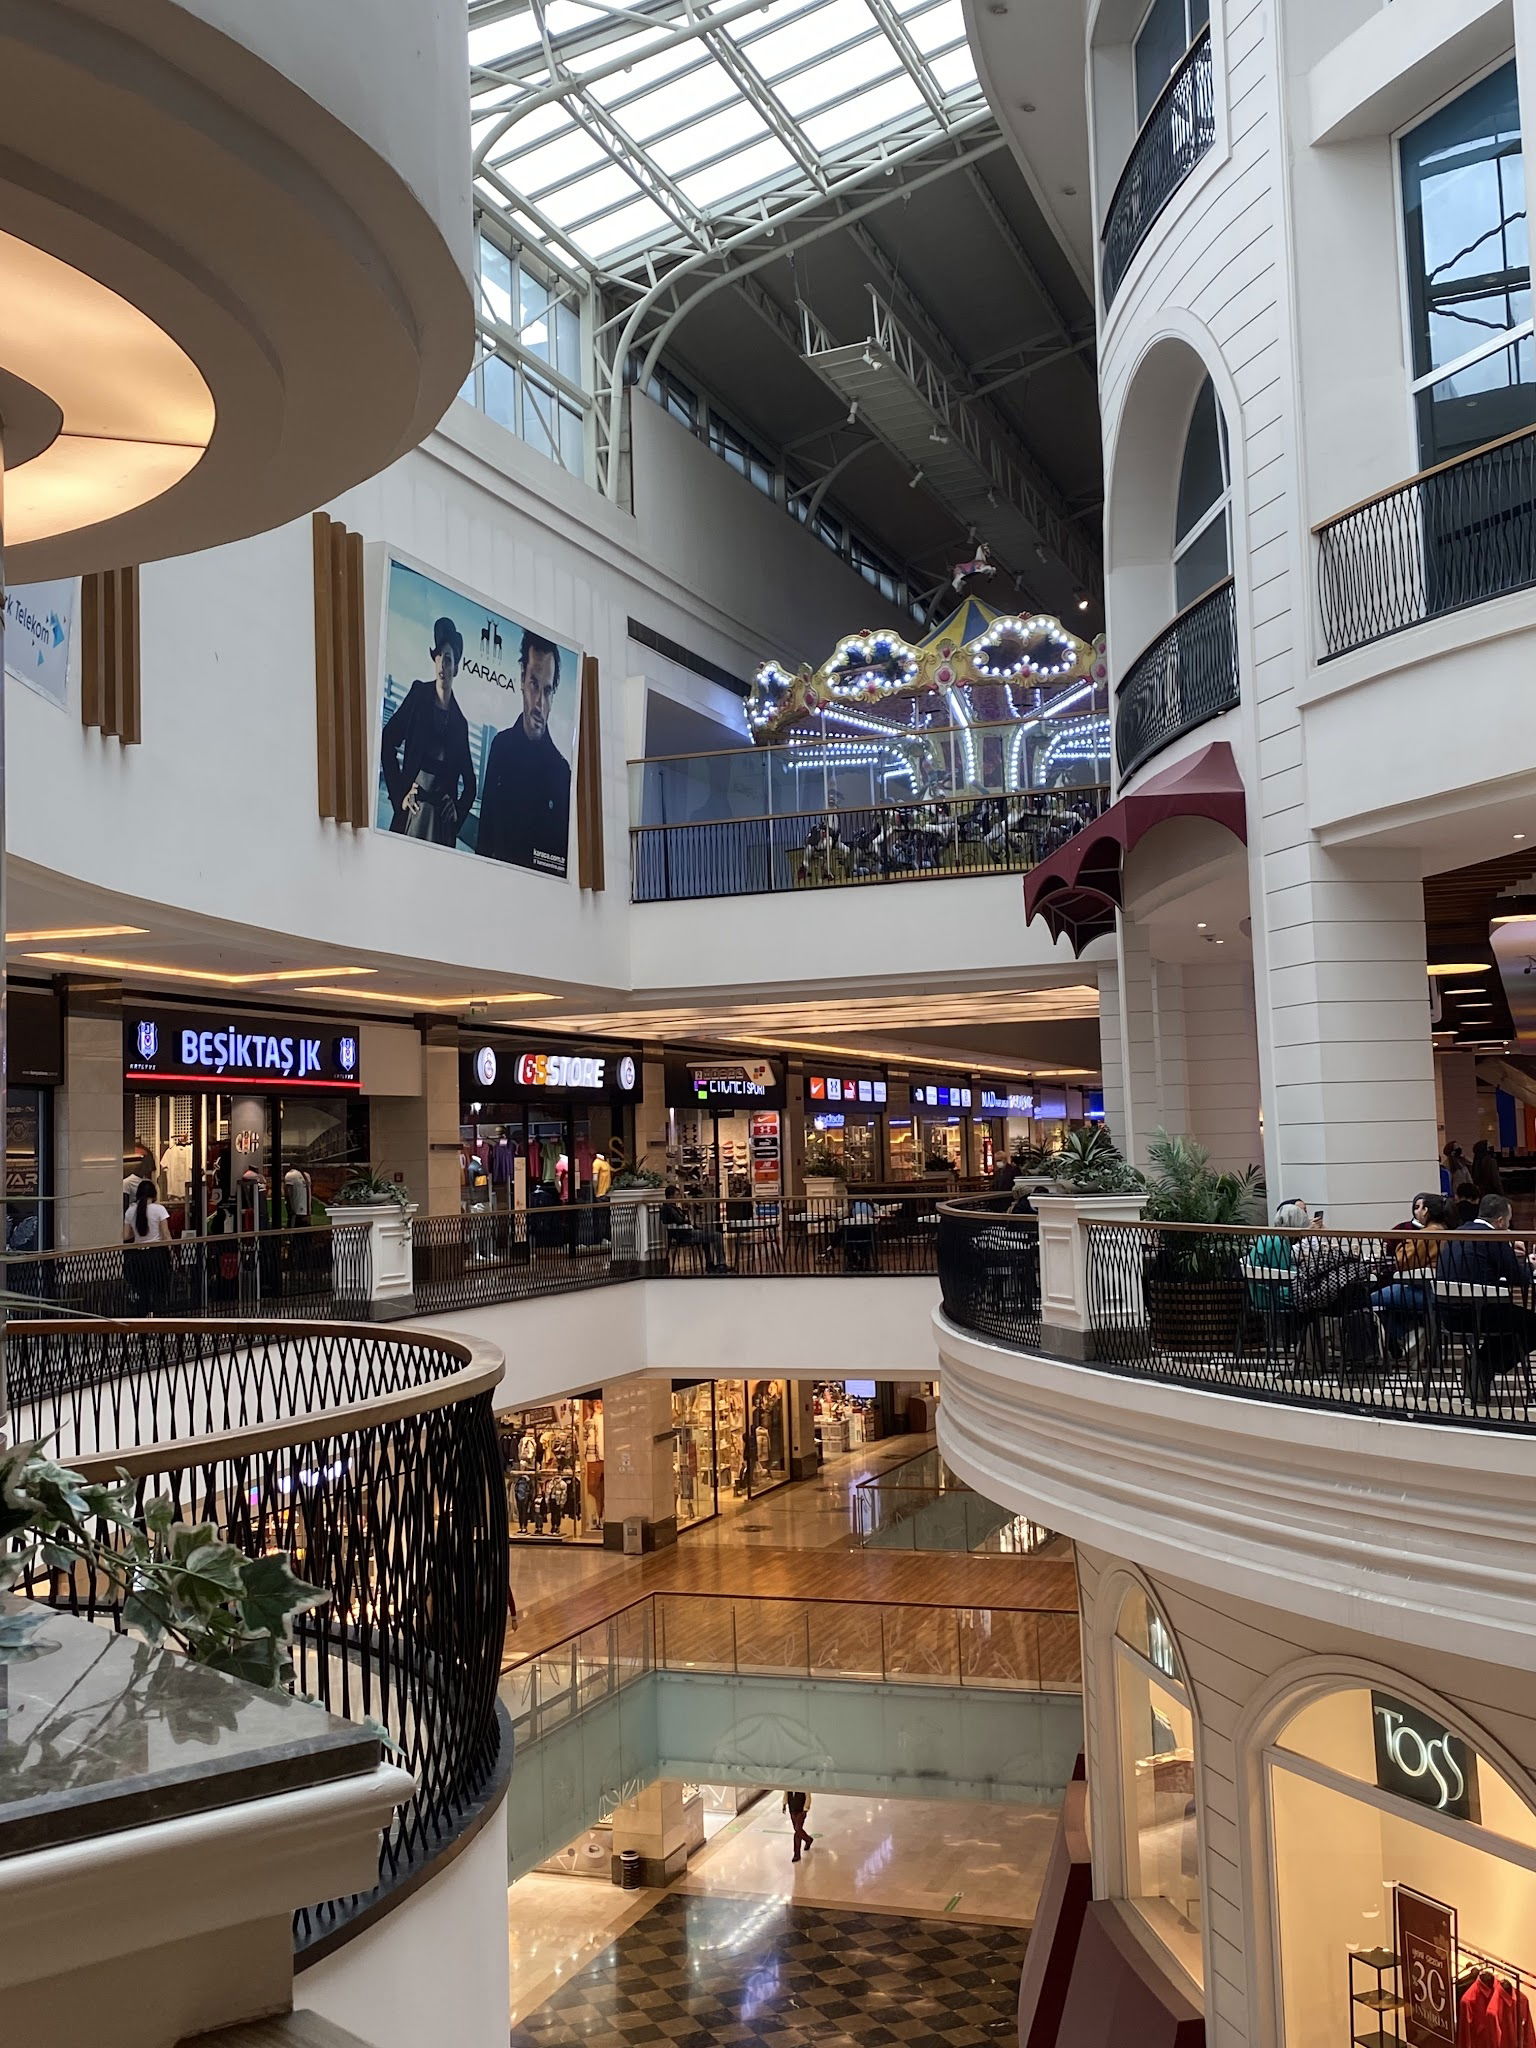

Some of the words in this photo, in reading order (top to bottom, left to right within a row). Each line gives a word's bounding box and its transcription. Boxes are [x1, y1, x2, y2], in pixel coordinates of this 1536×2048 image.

[16, 600, 50, 645] Telekom
[463, 657, 515, 692] KARACA
[181, 1026, 294, 1076] BEŞİKTAŞ
[298, 1039, 321, 1076] JK
